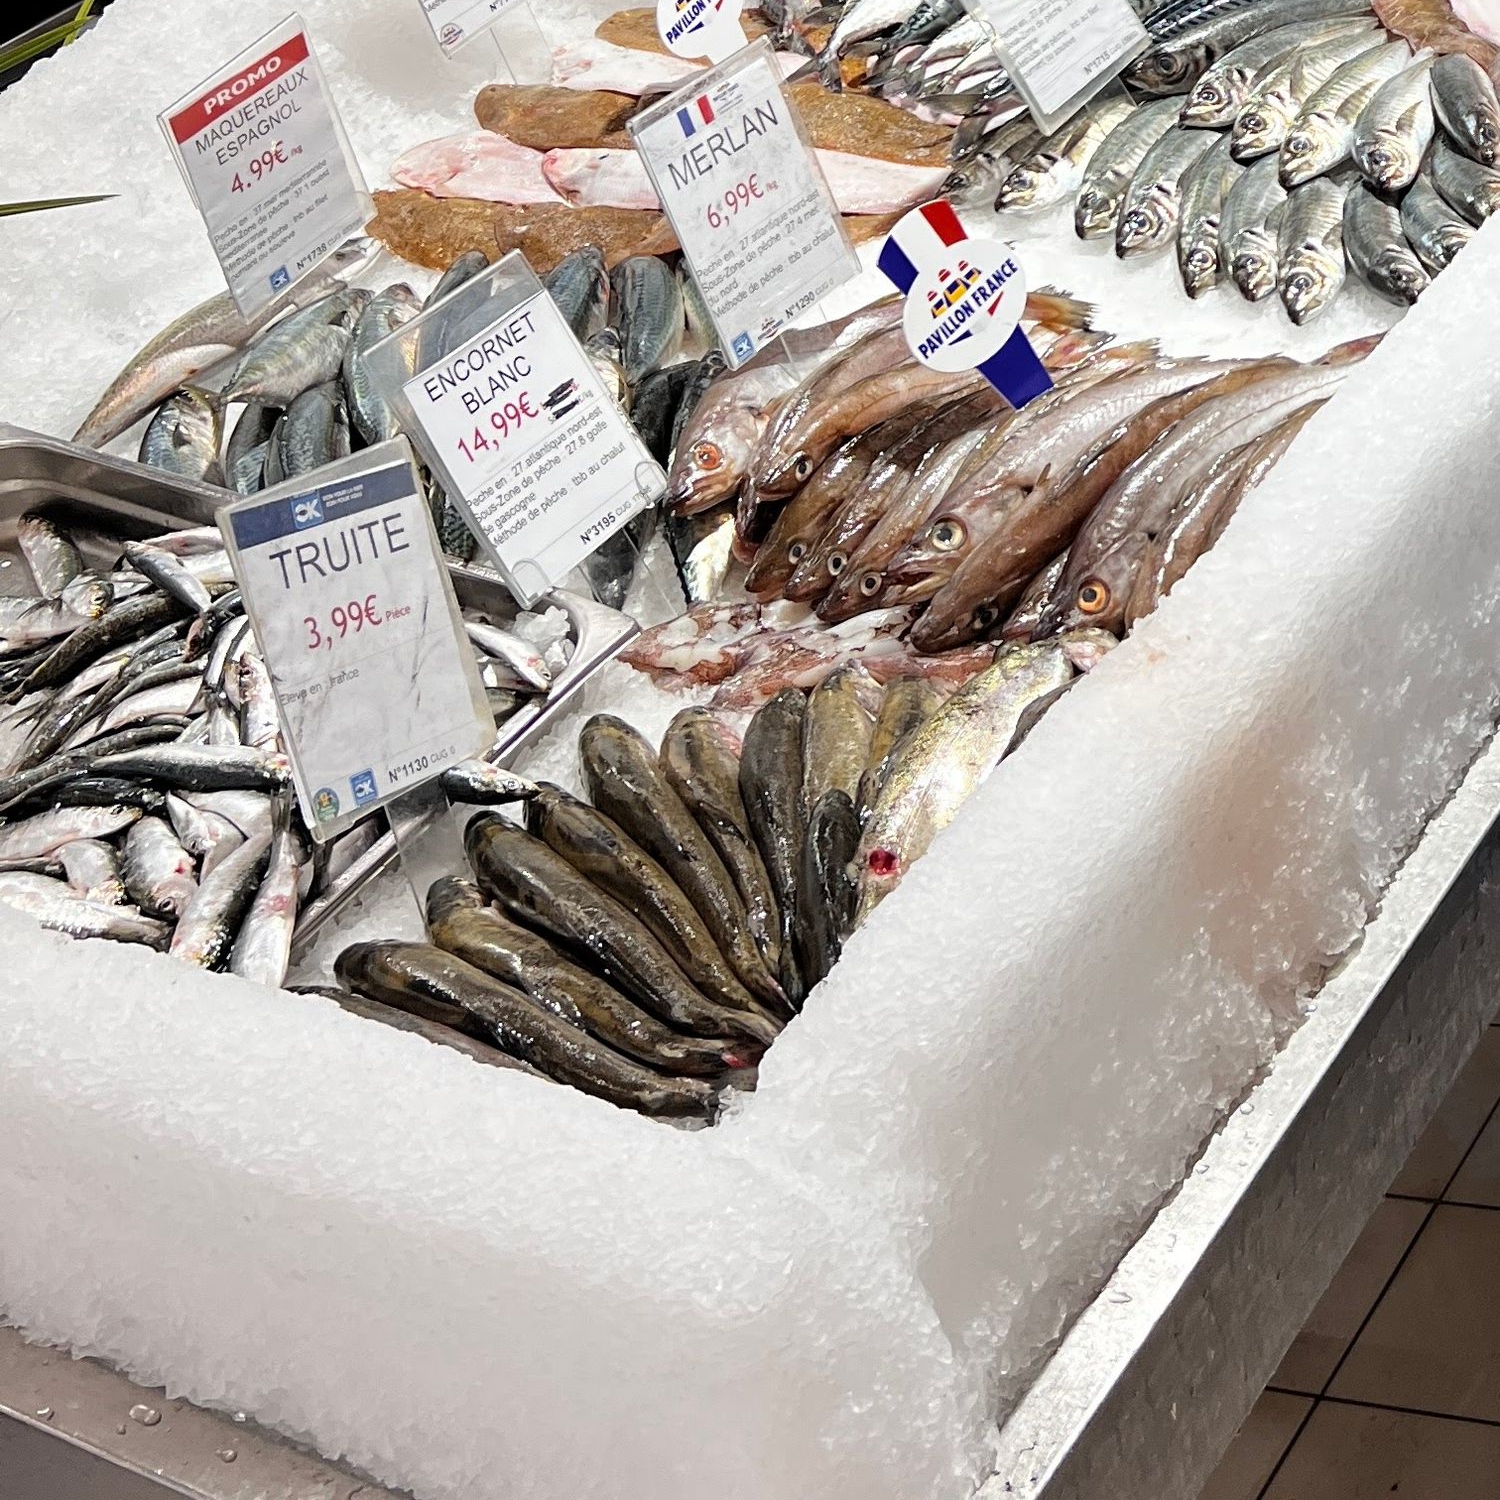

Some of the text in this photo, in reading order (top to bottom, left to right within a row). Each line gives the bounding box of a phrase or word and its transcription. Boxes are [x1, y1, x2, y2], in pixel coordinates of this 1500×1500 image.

[195, 67, 309, 155] MAQUEREAUX
[203, 55, 282, 116] PROMO
[215, 98, 303, 167] ESPAGNOL
[667, 99, 780, 191] MERLAN
[231, 140, 289, 194] 4.99€
[706, 172, 765, 230] 6,99€
[916, 257, 1018, 360] PAVILLON FRANCE
[423, 311, 536, 402] ENCORNET
[461, 355, 533, 415] BLANC
[457, 390, 540, 463] 14,99€
[269, 513, 411, 590] TRUITE
[579, 511, 617, 546] N°3195
[303, 593, 383, 651] 3,99€
[388, 755, 430, 785] N°1130
